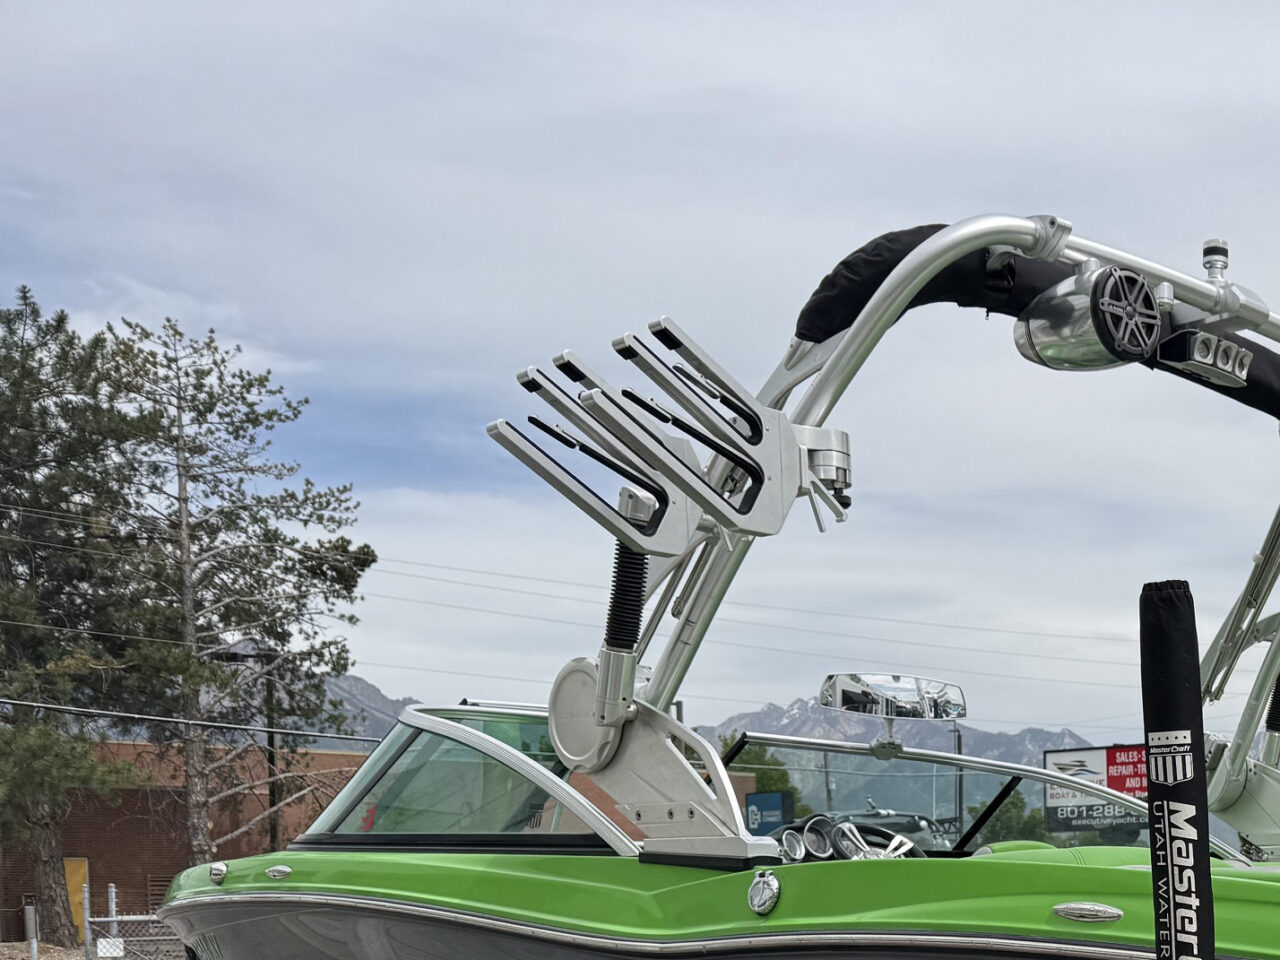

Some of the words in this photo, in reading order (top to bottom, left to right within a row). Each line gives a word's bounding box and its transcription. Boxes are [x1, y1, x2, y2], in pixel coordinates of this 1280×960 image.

[1125, 778, 1141, 788] AND
[1152, 801, 1167, 866] UTAH
[1158, 877, 1171, 958] WATER
